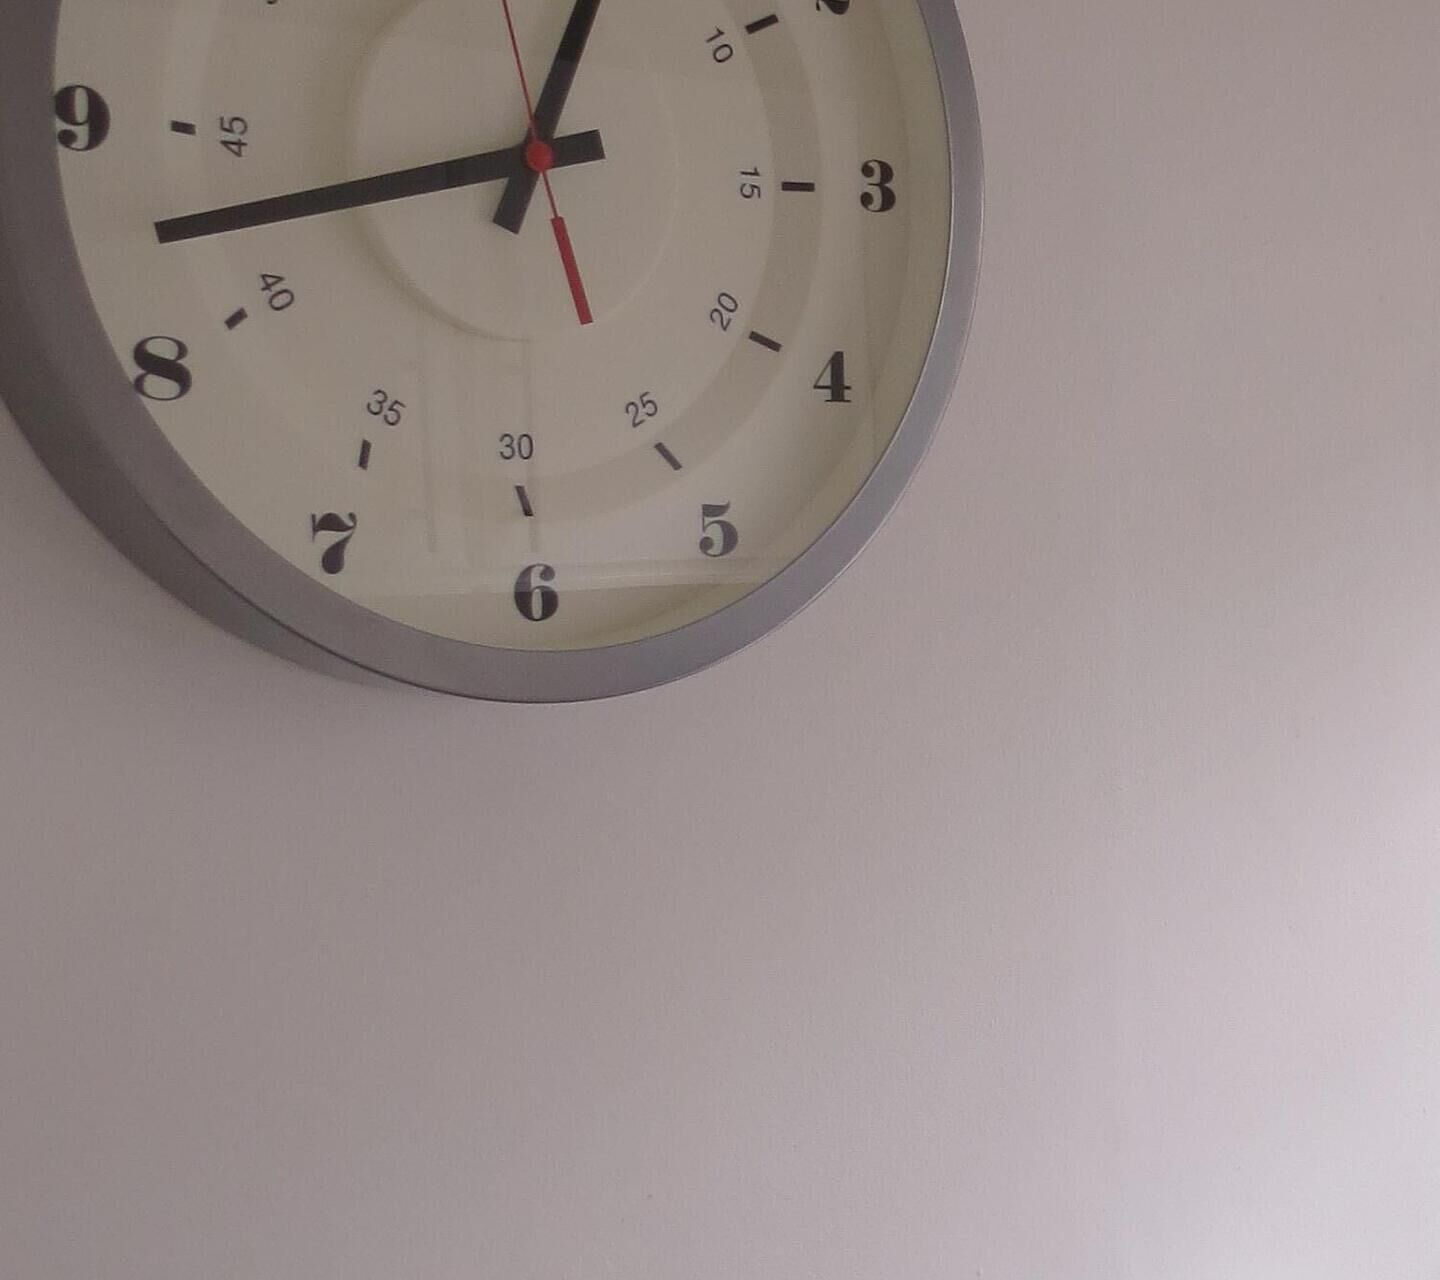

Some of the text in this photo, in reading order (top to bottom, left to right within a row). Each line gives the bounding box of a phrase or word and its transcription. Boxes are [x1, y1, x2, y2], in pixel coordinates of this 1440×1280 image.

[707, 28, 733, 63] 10
[54, 84, 110, 152] 9
[221, 116, 247, 158] 45
[740, 167, 761, 199] 15
[860, 160, 896, 212] 3
[260, 273, 294, 312] 40
[710, 293, 739, 331] 20
[133, 336, 191, 401] 8
[814, 351, 851, 402] 4
[366, 389, 405, 426] 35
[625, 392, 658, 427] 25
[499, 432, 533, 460] 30
[312, 513, 356, 574] 7
[699, 503, 738, 557] 5
[514, 565, 558, 621] 6
